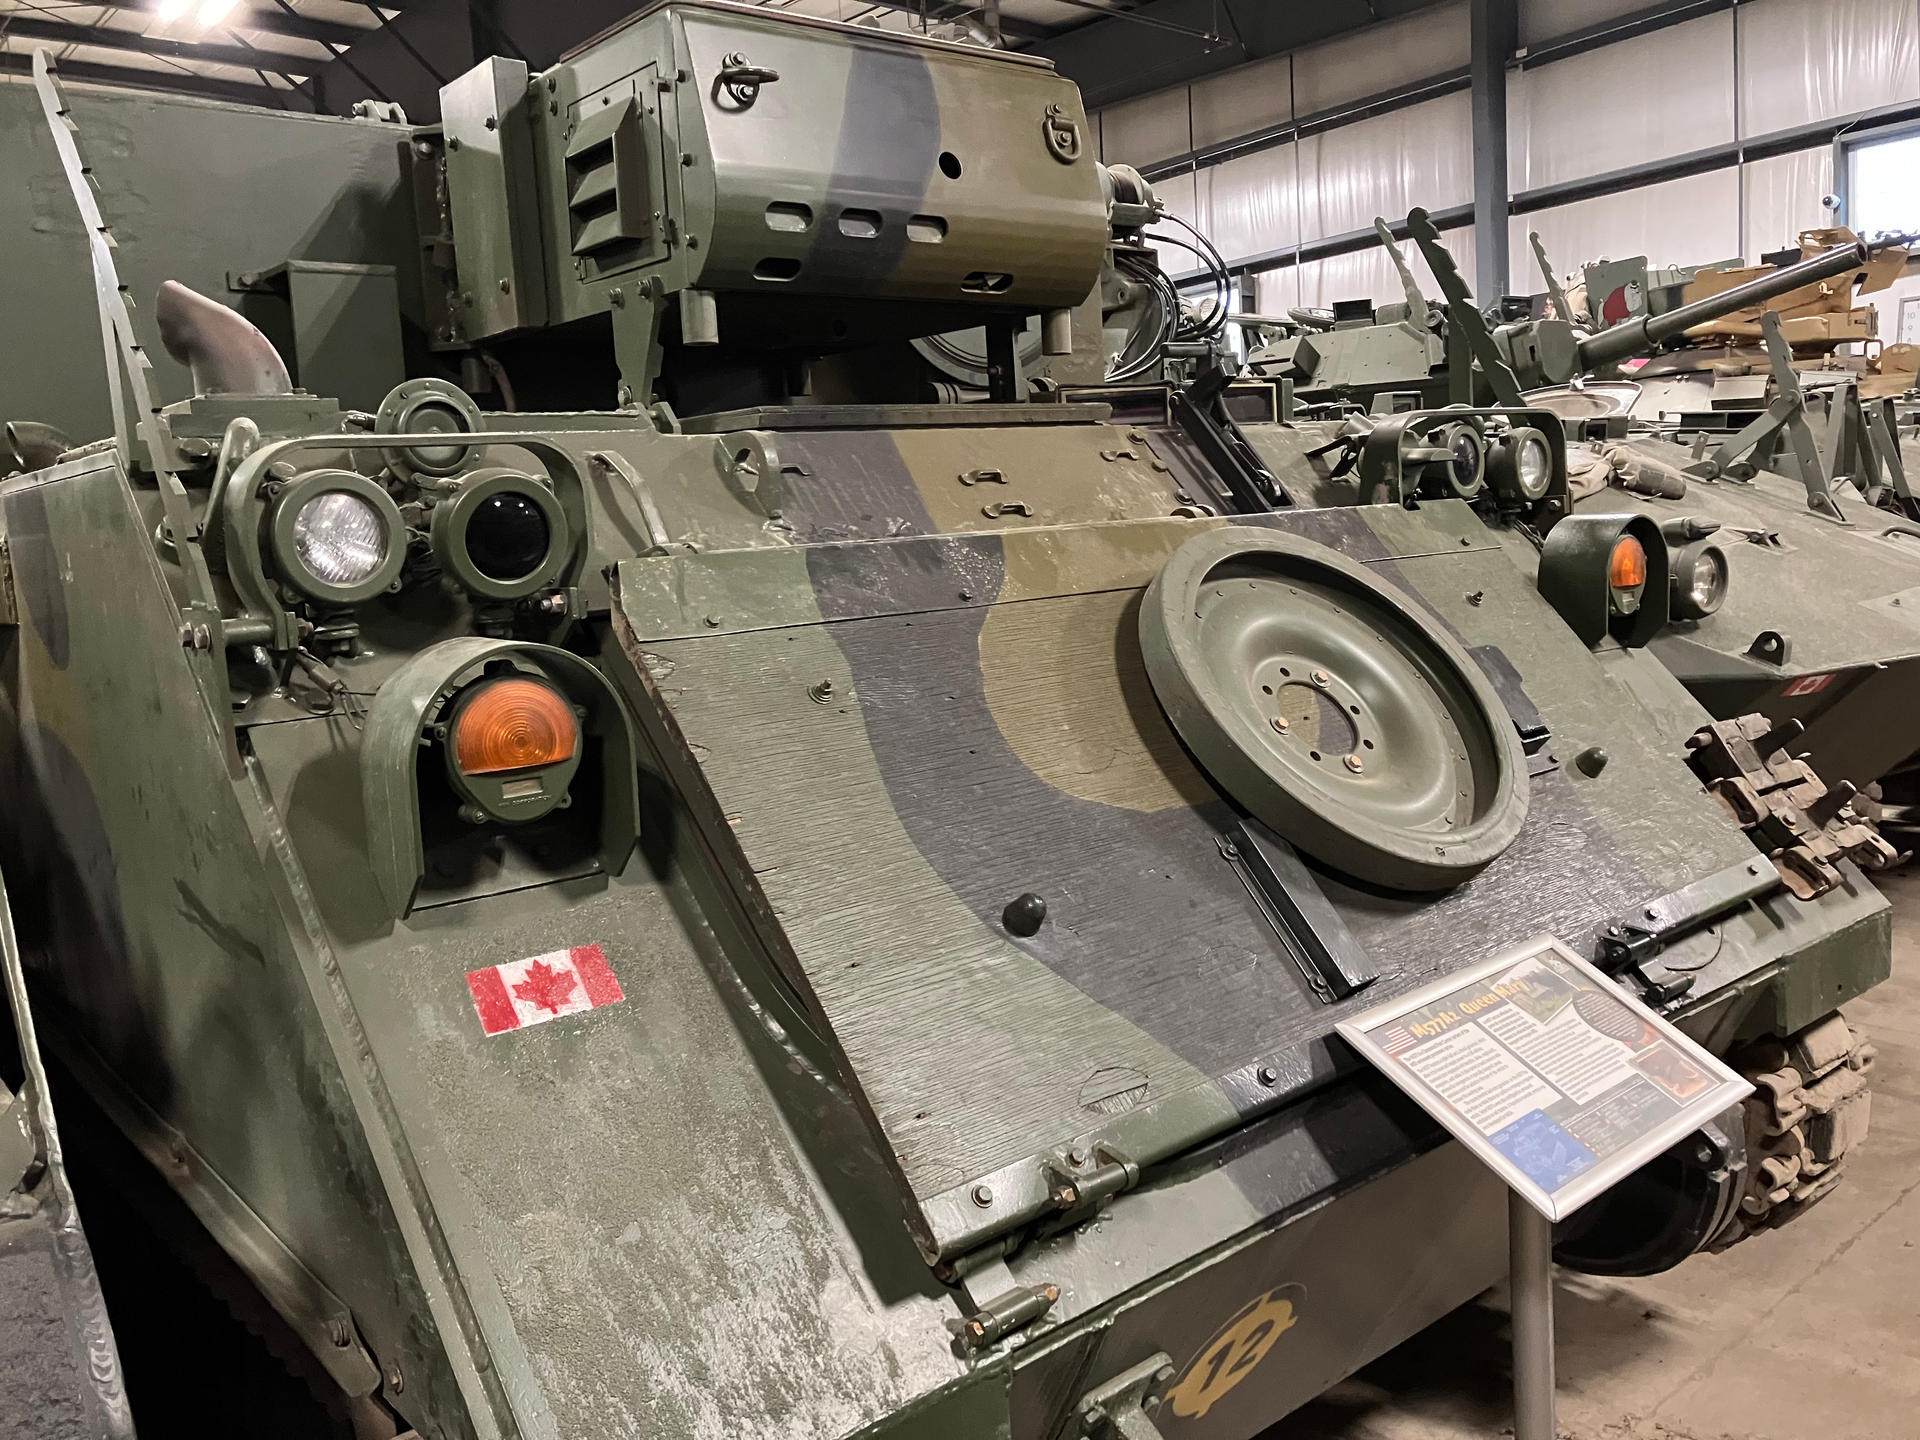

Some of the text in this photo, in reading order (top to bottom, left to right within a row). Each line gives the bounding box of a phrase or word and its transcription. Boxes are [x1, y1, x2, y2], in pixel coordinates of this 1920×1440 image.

[1409, 979, 1530, 1038] M577A2 Queen Mary
[1198, 1318, 1275, 1394] 12
